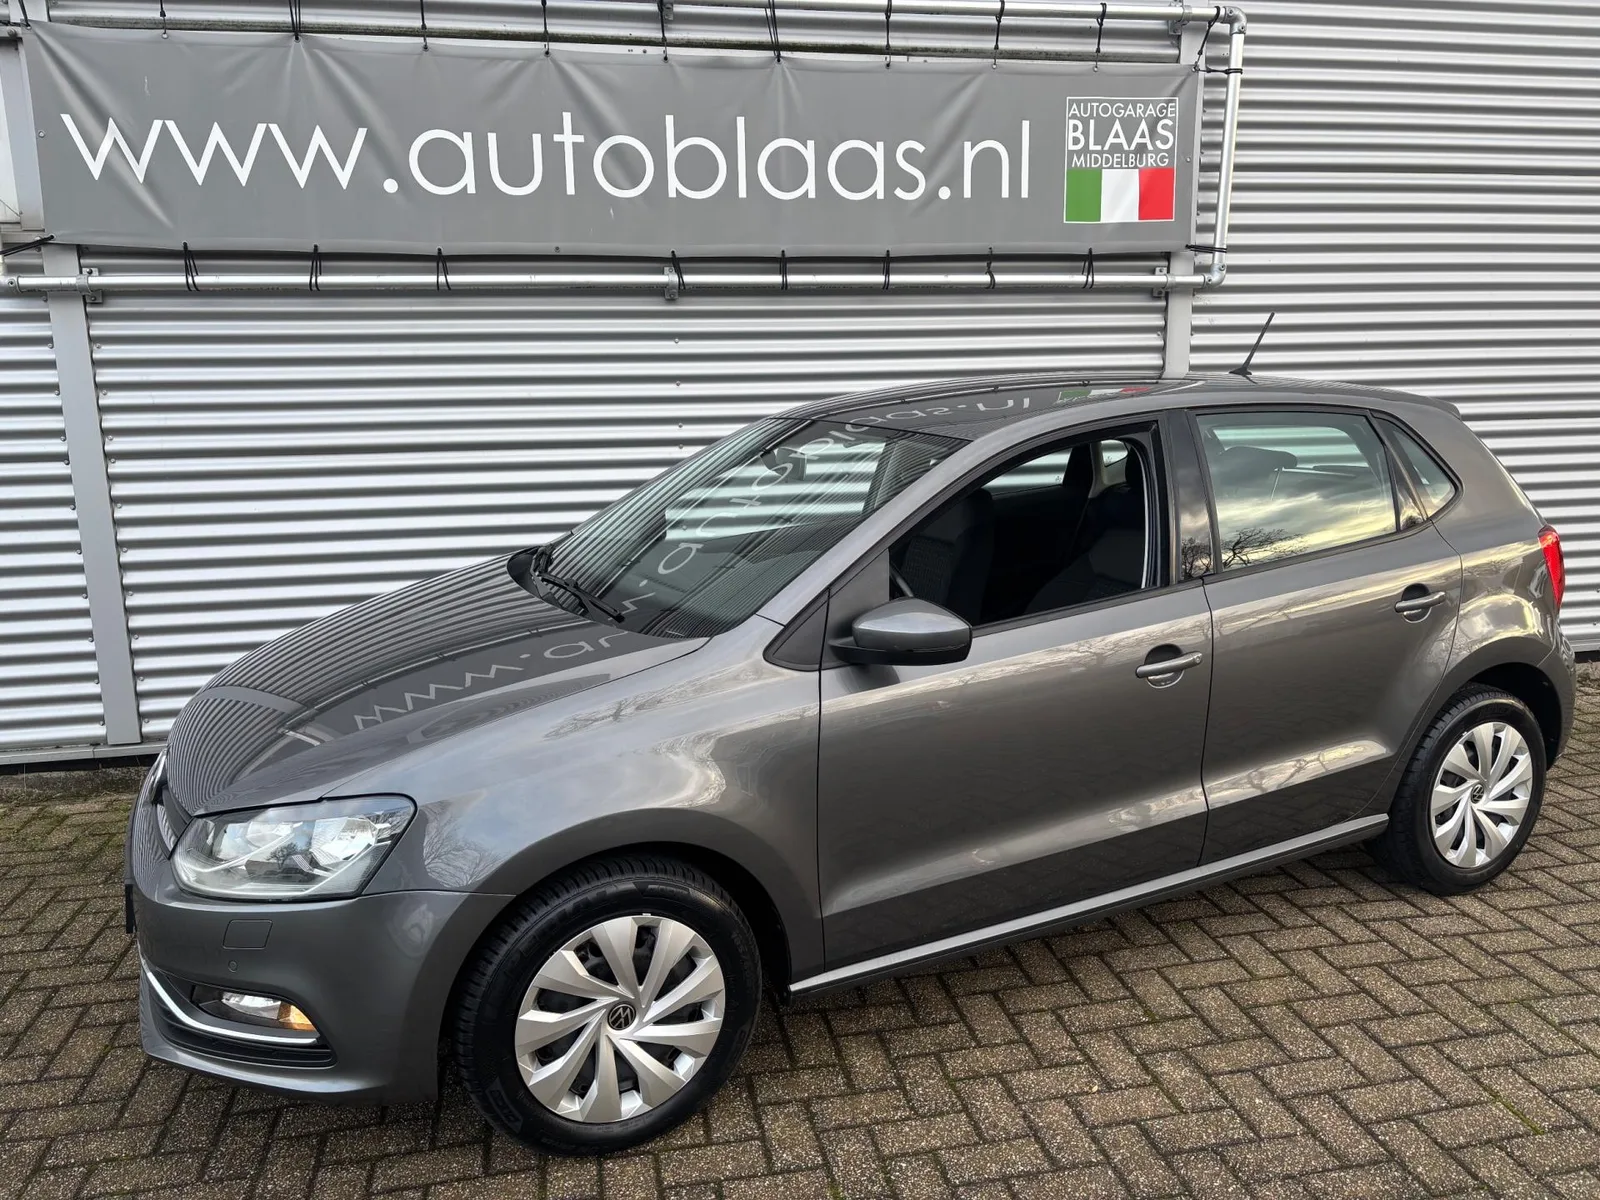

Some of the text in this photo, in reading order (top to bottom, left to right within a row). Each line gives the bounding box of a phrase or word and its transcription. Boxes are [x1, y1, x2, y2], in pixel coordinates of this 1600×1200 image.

[1068, 102, 1176, 118] AUTOGARAGE
[1067, 118, 1175, 151] BLAAS
[60, 111, 1030, 200] www.autoblaas.nl
[1071, 152, 1170, 168] MIDDELBURG
